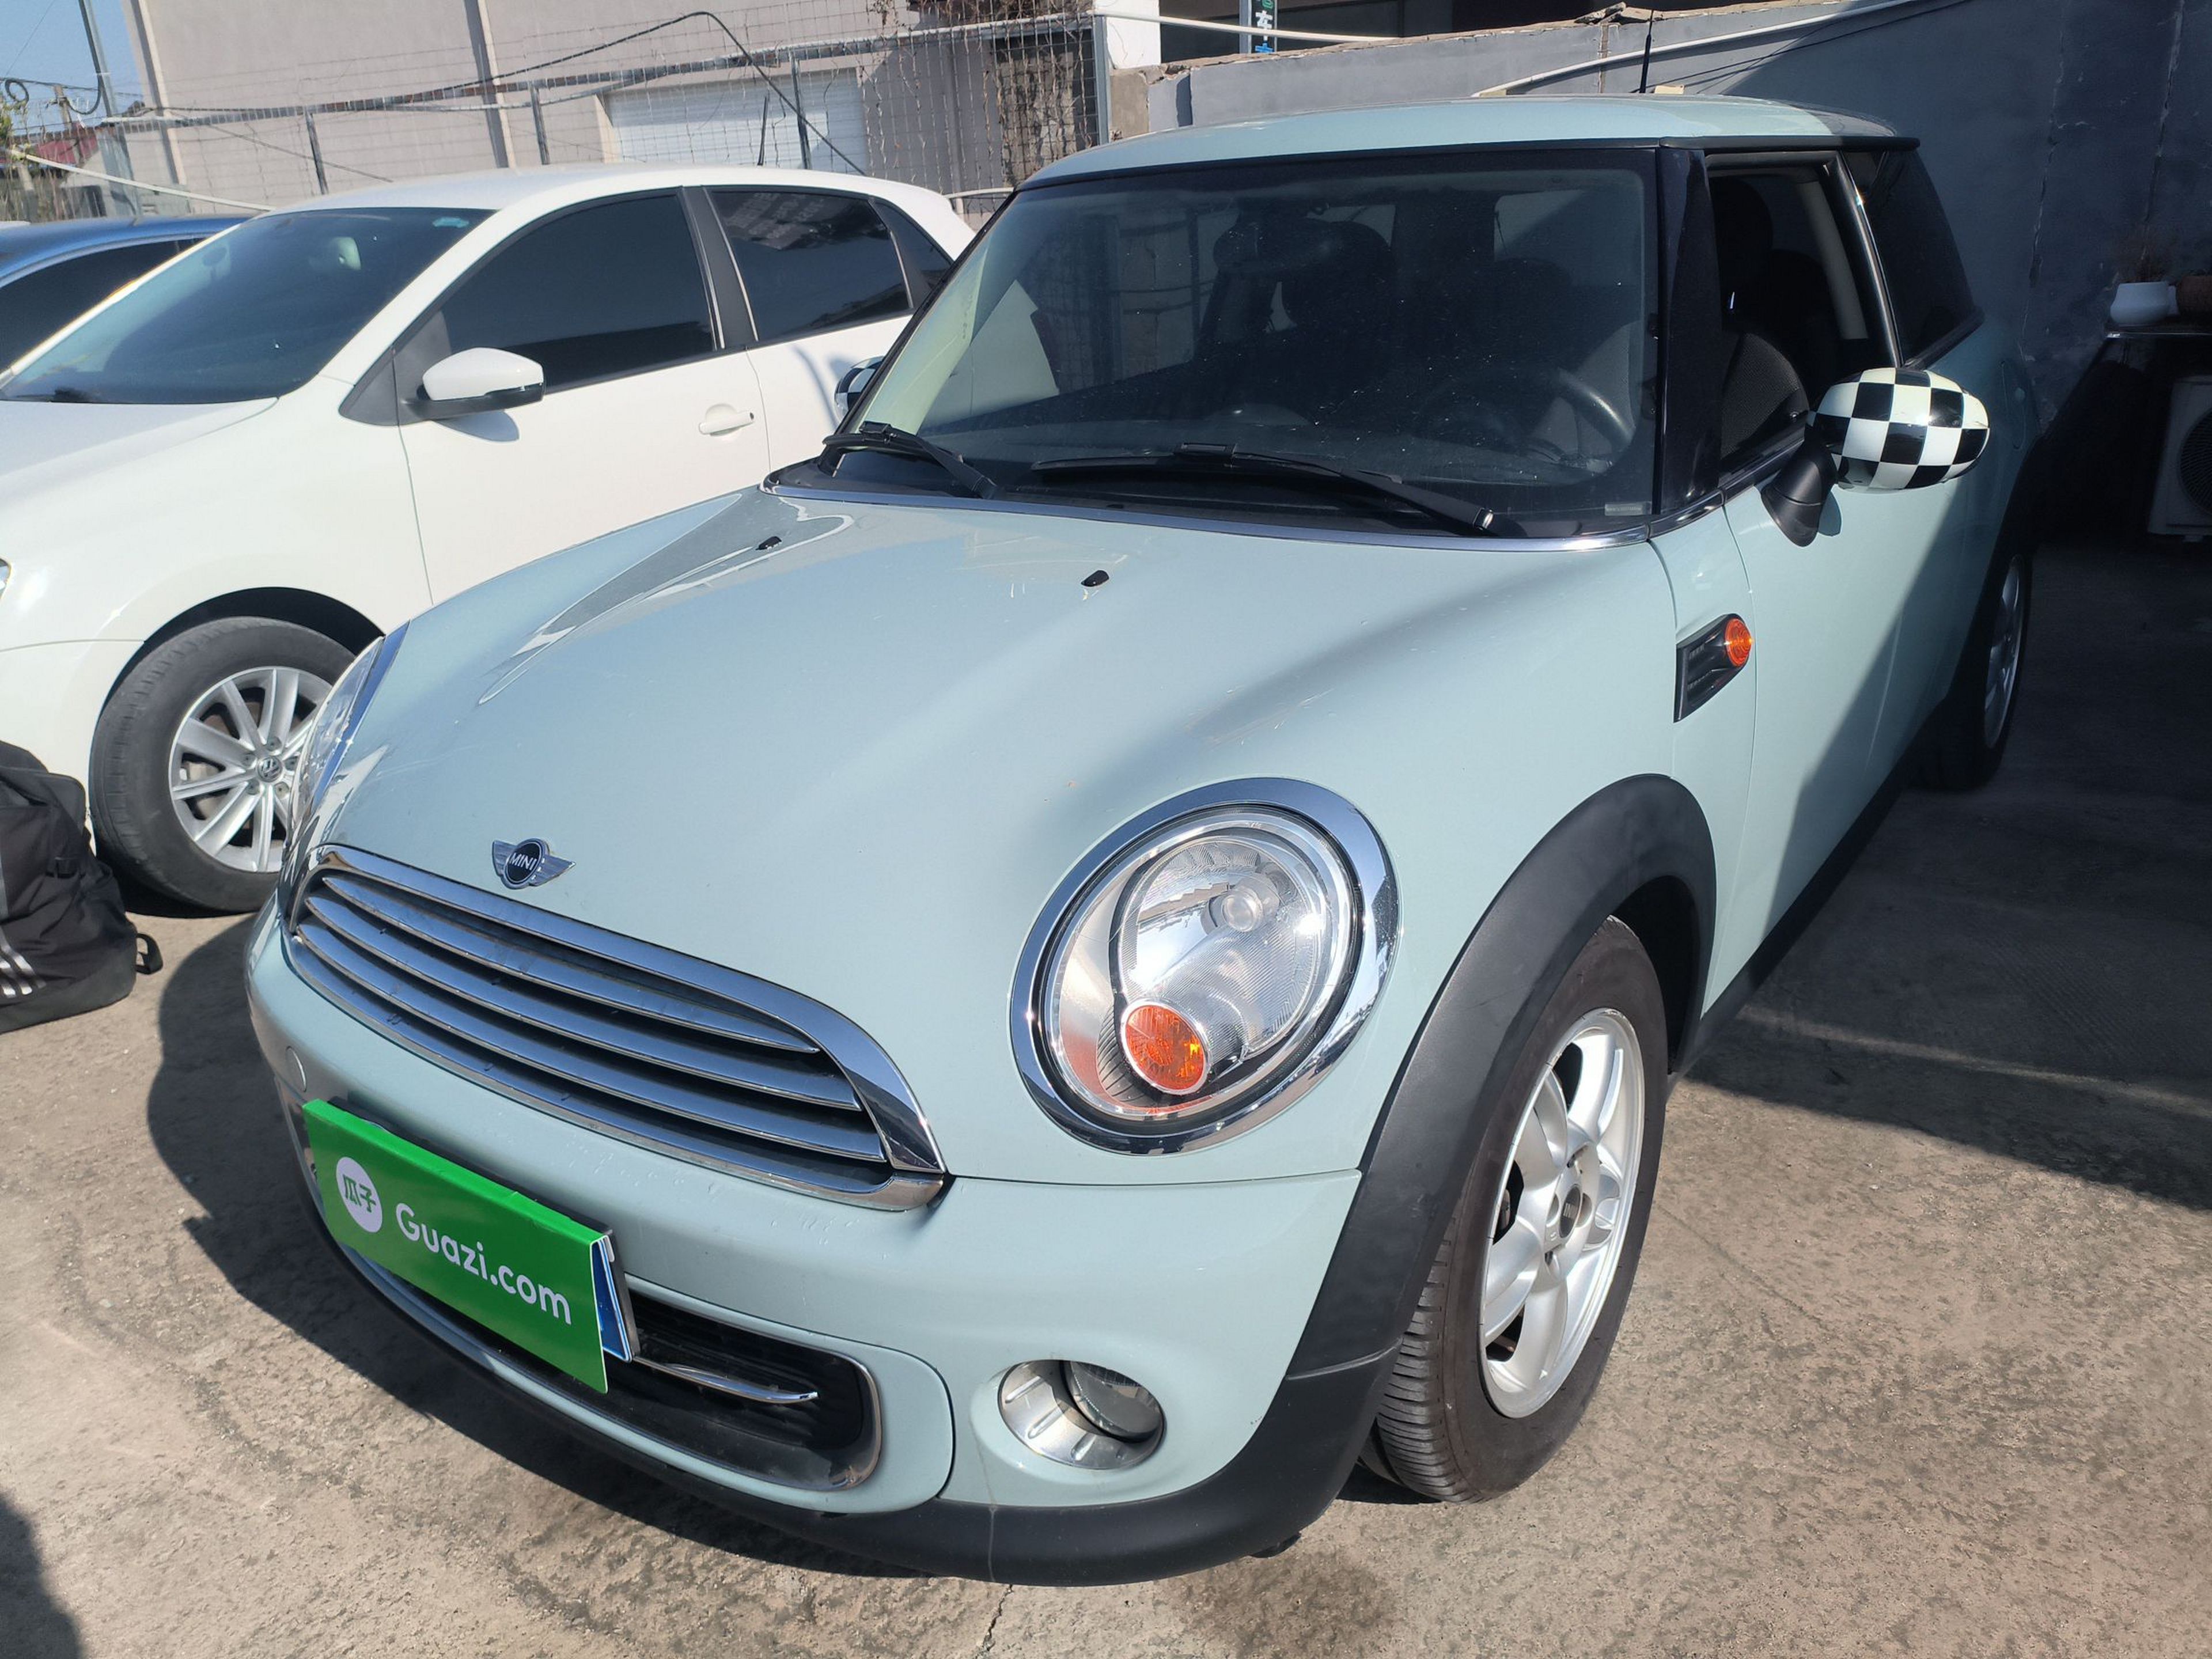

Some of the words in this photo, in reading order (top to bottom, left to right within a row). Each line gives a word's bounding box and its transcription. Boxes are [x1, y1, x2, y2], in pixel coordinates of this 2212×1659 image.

[510, 853, 537, 870] MINI
[342, 1174, 376, 1213] 瓜子
[396, 1203, 571, 1324] Guazi.com
